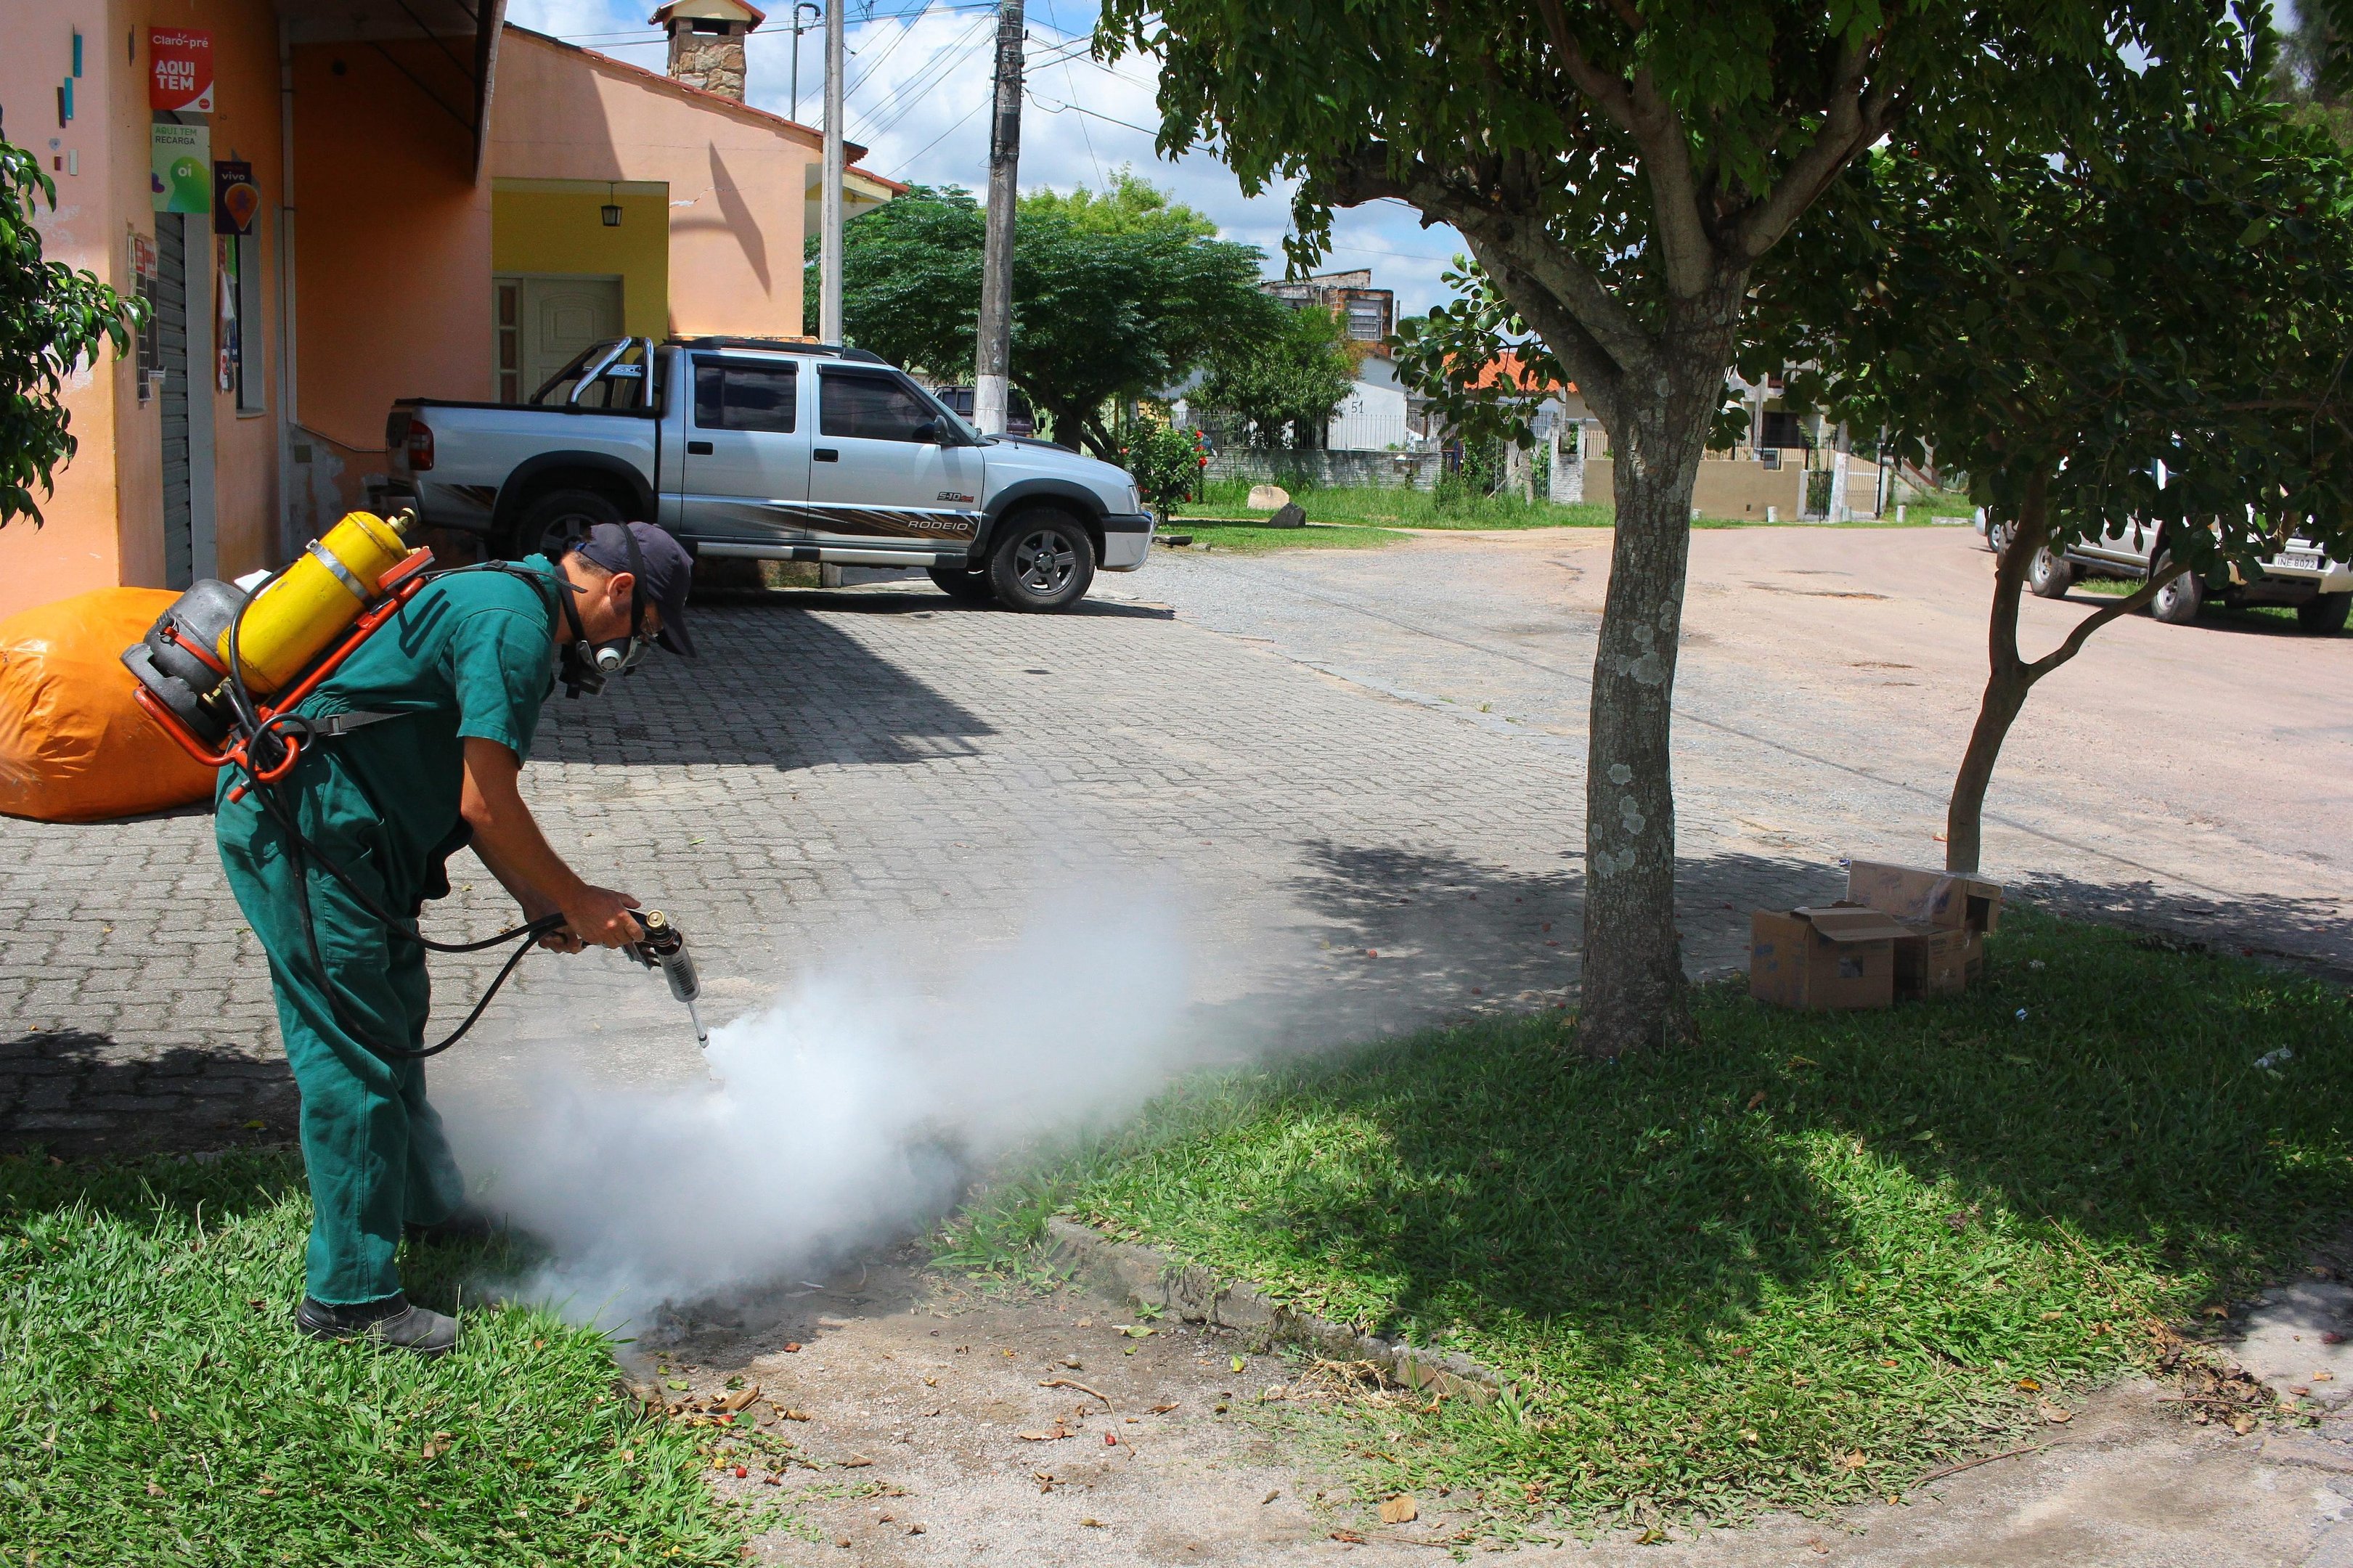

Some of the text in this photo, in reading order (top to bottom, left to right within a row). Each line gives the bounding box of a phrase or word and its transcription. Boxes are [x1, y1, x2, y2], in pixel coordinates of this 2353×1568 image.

[155, 60, 195, 75] AQUI
[157, 75, 194, 91] TEM
[155, 126, 197, 136] AQUI TEM
[155, 136, 195, 145] RECARGA
[178, 163, 192, 178] oi
[221, 171, 245, 181] vivo
[1351, 400, 1364, 414] 51
[908, 520, 968, 531] RODEIO
[2277, 558, 2315, 569] INE 8072
